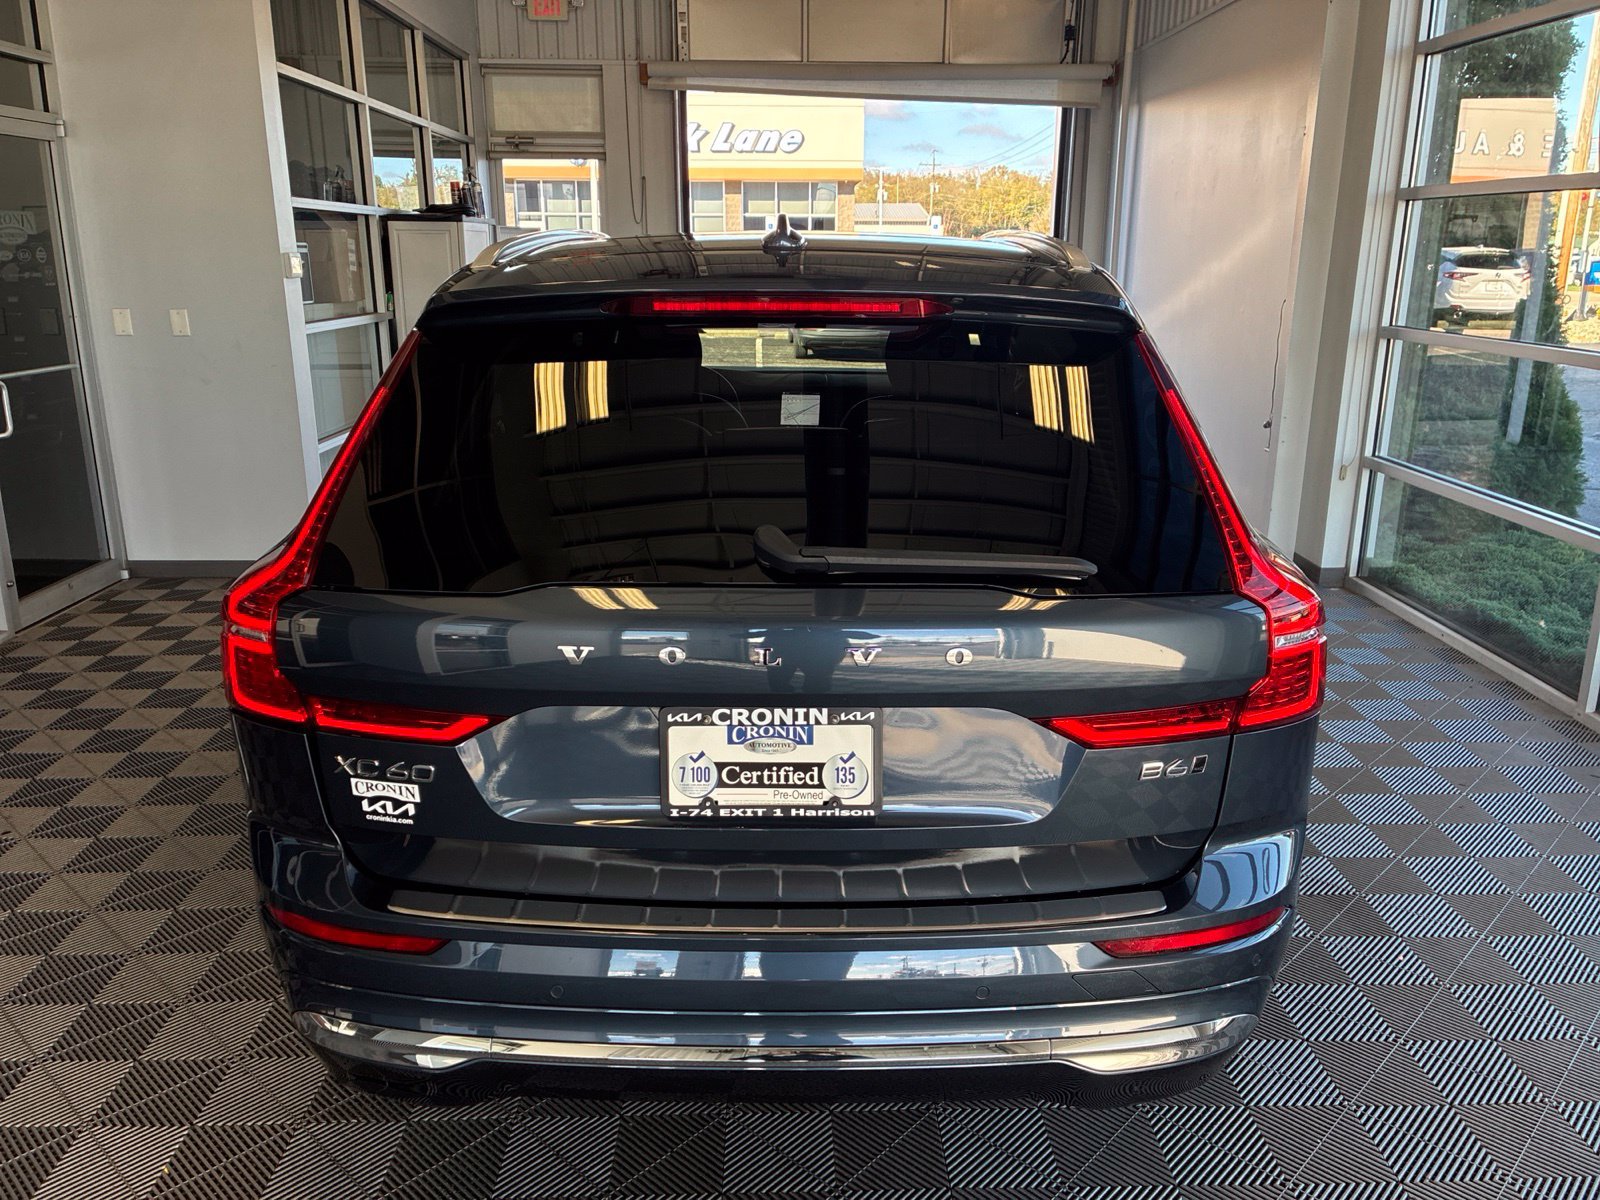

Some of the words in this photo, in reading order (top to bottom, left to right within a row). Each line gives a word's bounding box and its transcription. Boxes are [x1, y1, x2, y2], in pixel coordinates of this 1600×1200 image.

[710, 122, 805, 154] Lane
[557, 646, 974, 666] VOLVO
[712, 708, 828, 725] CRONIN
[732, 725, 809, 744] CRONIN
[679, 766, 686, 783] 7
[690, 766, 711, 783] 100
[721, 765, 820, 785] Certified
[835, 766, 856, 784] 135
[1139, 758, 1188, 781] B6
[354, 779, 417, 800] CRONIN
[773, 789, 824, 800] Pre-Owned
[365, 814, 414, 825] croninkia.com
[670, 808, 714, 817] I-74
[719, 808, 766, 817] EXIT
[772, 808, 784, 817] 1
[791, 807, 875, 817] Harrison
